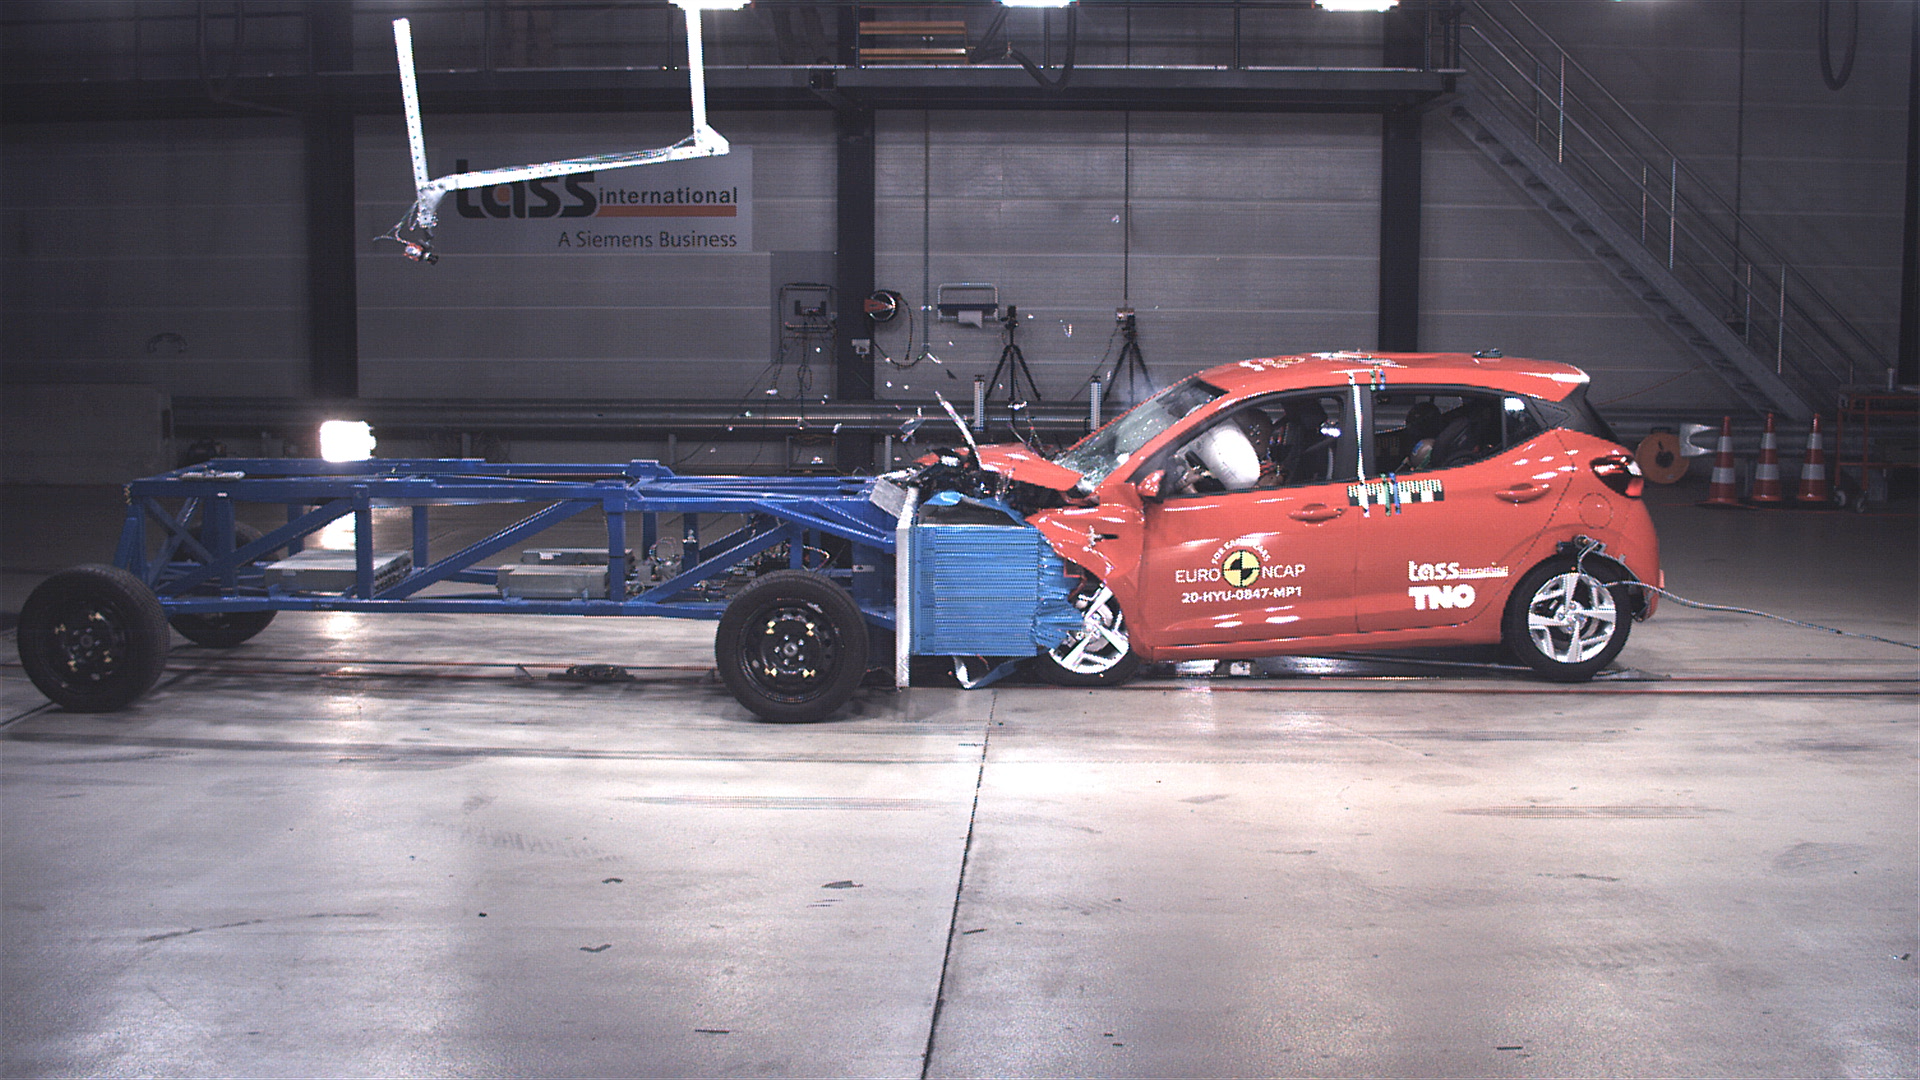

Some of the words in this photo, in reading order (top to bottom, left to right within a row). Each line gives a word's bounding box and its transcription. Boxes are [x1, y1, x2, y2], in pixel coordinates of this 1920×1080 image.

[456, 159, 597, 218] tass
[599, 187, 738, 204] international
[558, 231, 571, 248] A
[576, 231, 653, 248] Siemens
[659, 231, 738, 248] Business
[1175, 568, 1221, 583] EURO
[1261, 564, 1306, 579] NCAP
[1408, 560, 1460, 582] tass
[1181, 586, 1302, 604] 20-HYU-0847-MP1
[1408, 584, 1476, 610] TNO
